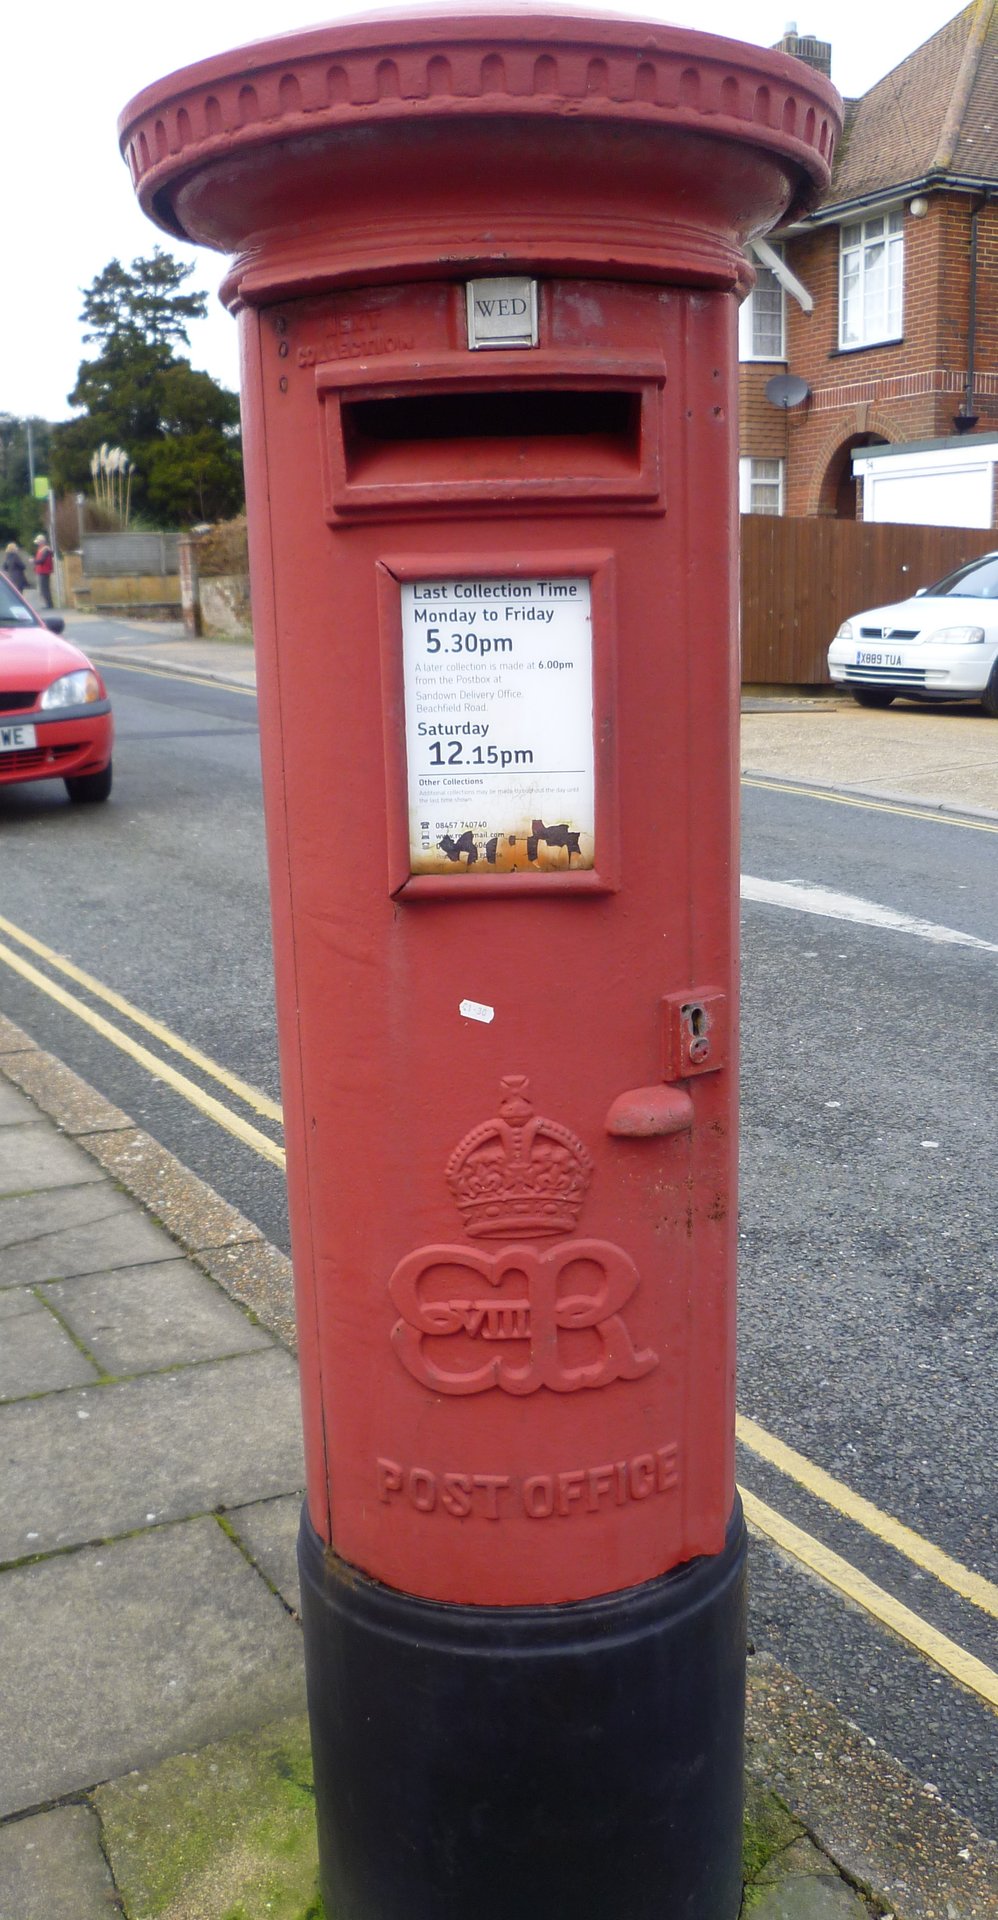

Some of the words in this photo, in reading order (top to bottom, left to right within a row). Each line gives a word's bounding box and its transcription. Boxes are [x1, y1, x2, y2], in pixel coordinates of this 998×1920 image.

[475, 298, 527, 317] WED
[413, 584, 448, 600] Last
[454, 583, 532, 599] Collection
[537, 582, 578, 597] Time
[414, 608, 476, 625] Monday
[482, 608, 498, 622] to
[505, 607, 555, 623] Friday
[426, 629, 513, 656] 5.30pm
[415, 663, 422, 673] A
[423, 663, 443, 672] later
[446, 661, 487, 672] collection
[489, 661, 497, 671] is
[499, 660, 524, 671] made
[526, 660, 536, 670] at
[538, 660, 574, 671] 6.00pm
[884, 654, 902, 666] TUA
[415, 676, 437, 686] from
[439, 675, 454, 685] the
[456, 674, 491, 685] Postbox
[493, 675, 502, 684] at
[416, 691, 457, 701] Sandown
[459, 689, 495, 701] Delivery
[416, 703, 462, 714] Beachfield
[417, 722, 490, 738] Saturday
[428, 741, 534, 768] 12.15pm
[419, 778, 440, 786] Other
[442, 778, 484, 786] Collections
[376, 1456, 510, 1521] POST
[523, 1442, 679, 1519] OFFICE
